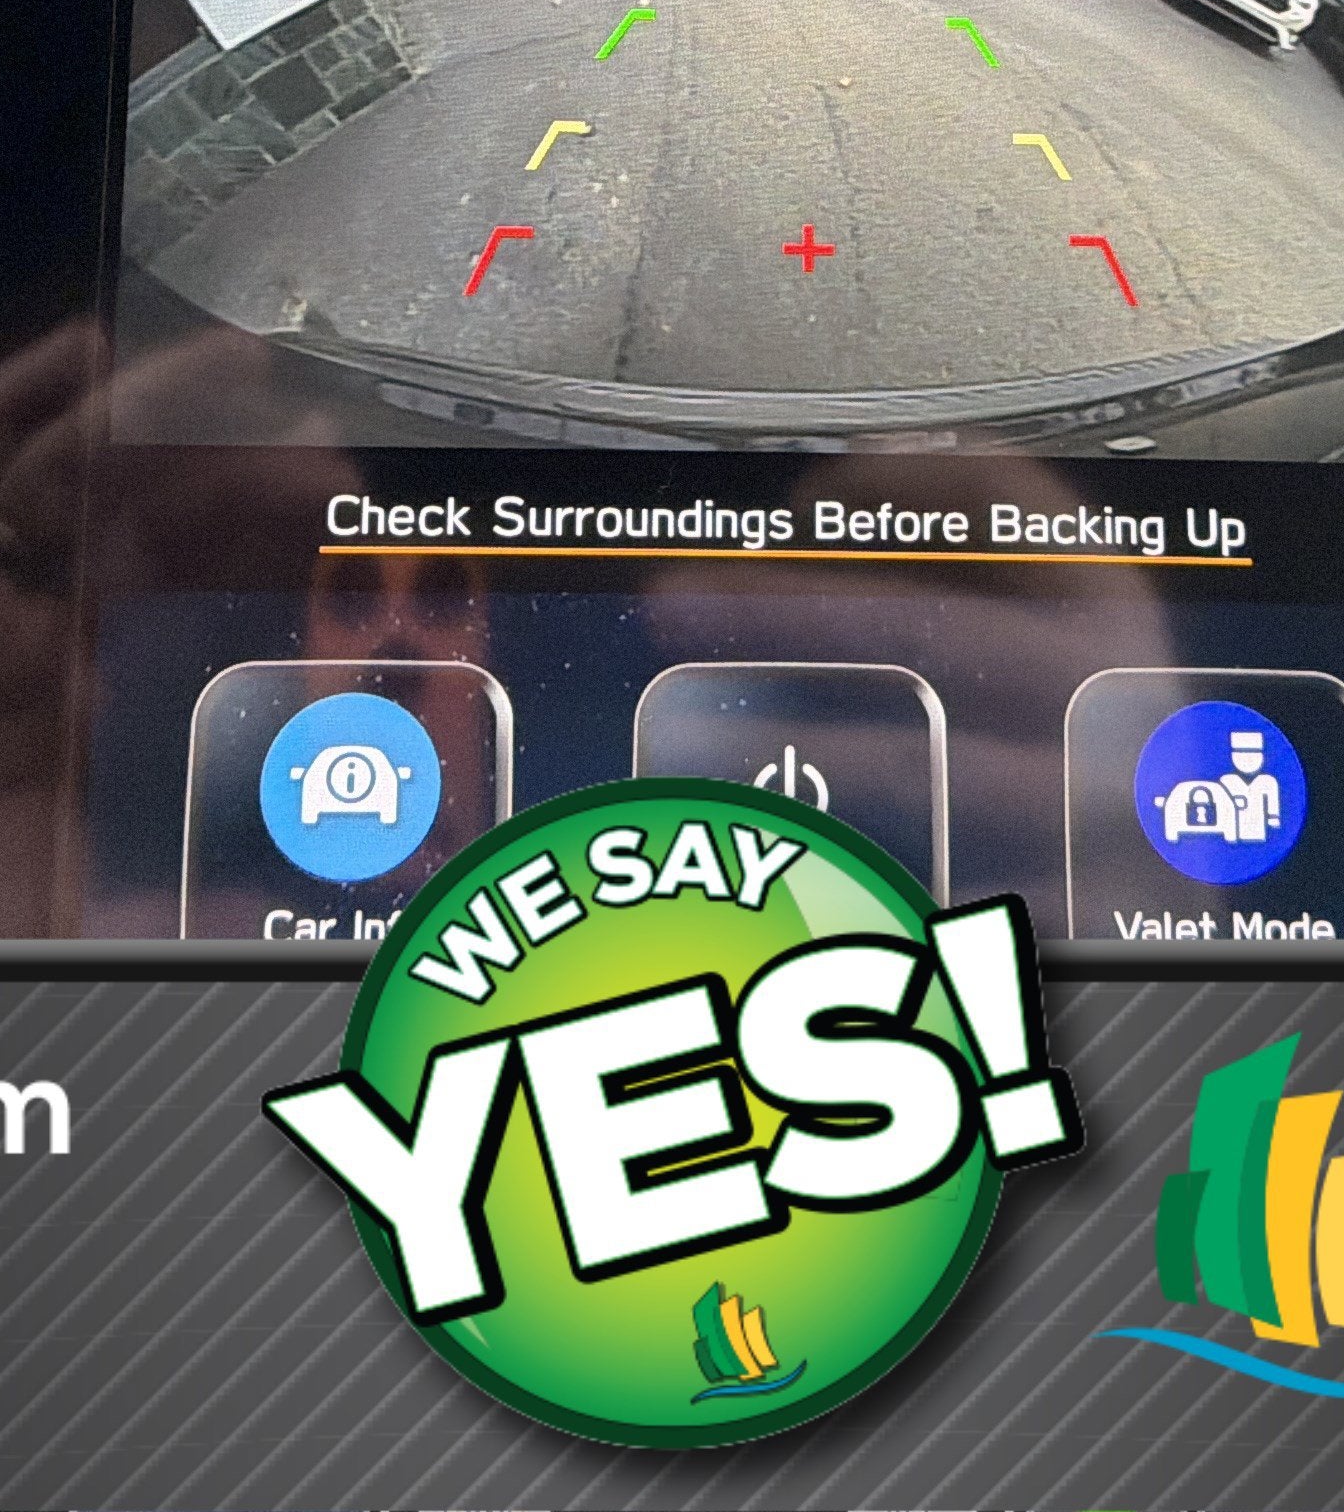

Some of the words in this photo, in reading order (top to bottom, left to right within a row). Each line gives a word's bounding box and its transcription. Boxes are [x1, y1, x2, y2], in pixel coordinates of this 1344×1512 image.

[326, 495, 470, 537] Check
[493, 497, 793, 550] Surroundings
[815, 502, 969, 544] Before
[991, 506, 1164, 555] Backing
[1188, 510, 1248, 555] Up
[263, 910, 337, 940] Car
[1114, 912, 1216, 940] Valet
[1233, 913, 1336, 940] Mode
